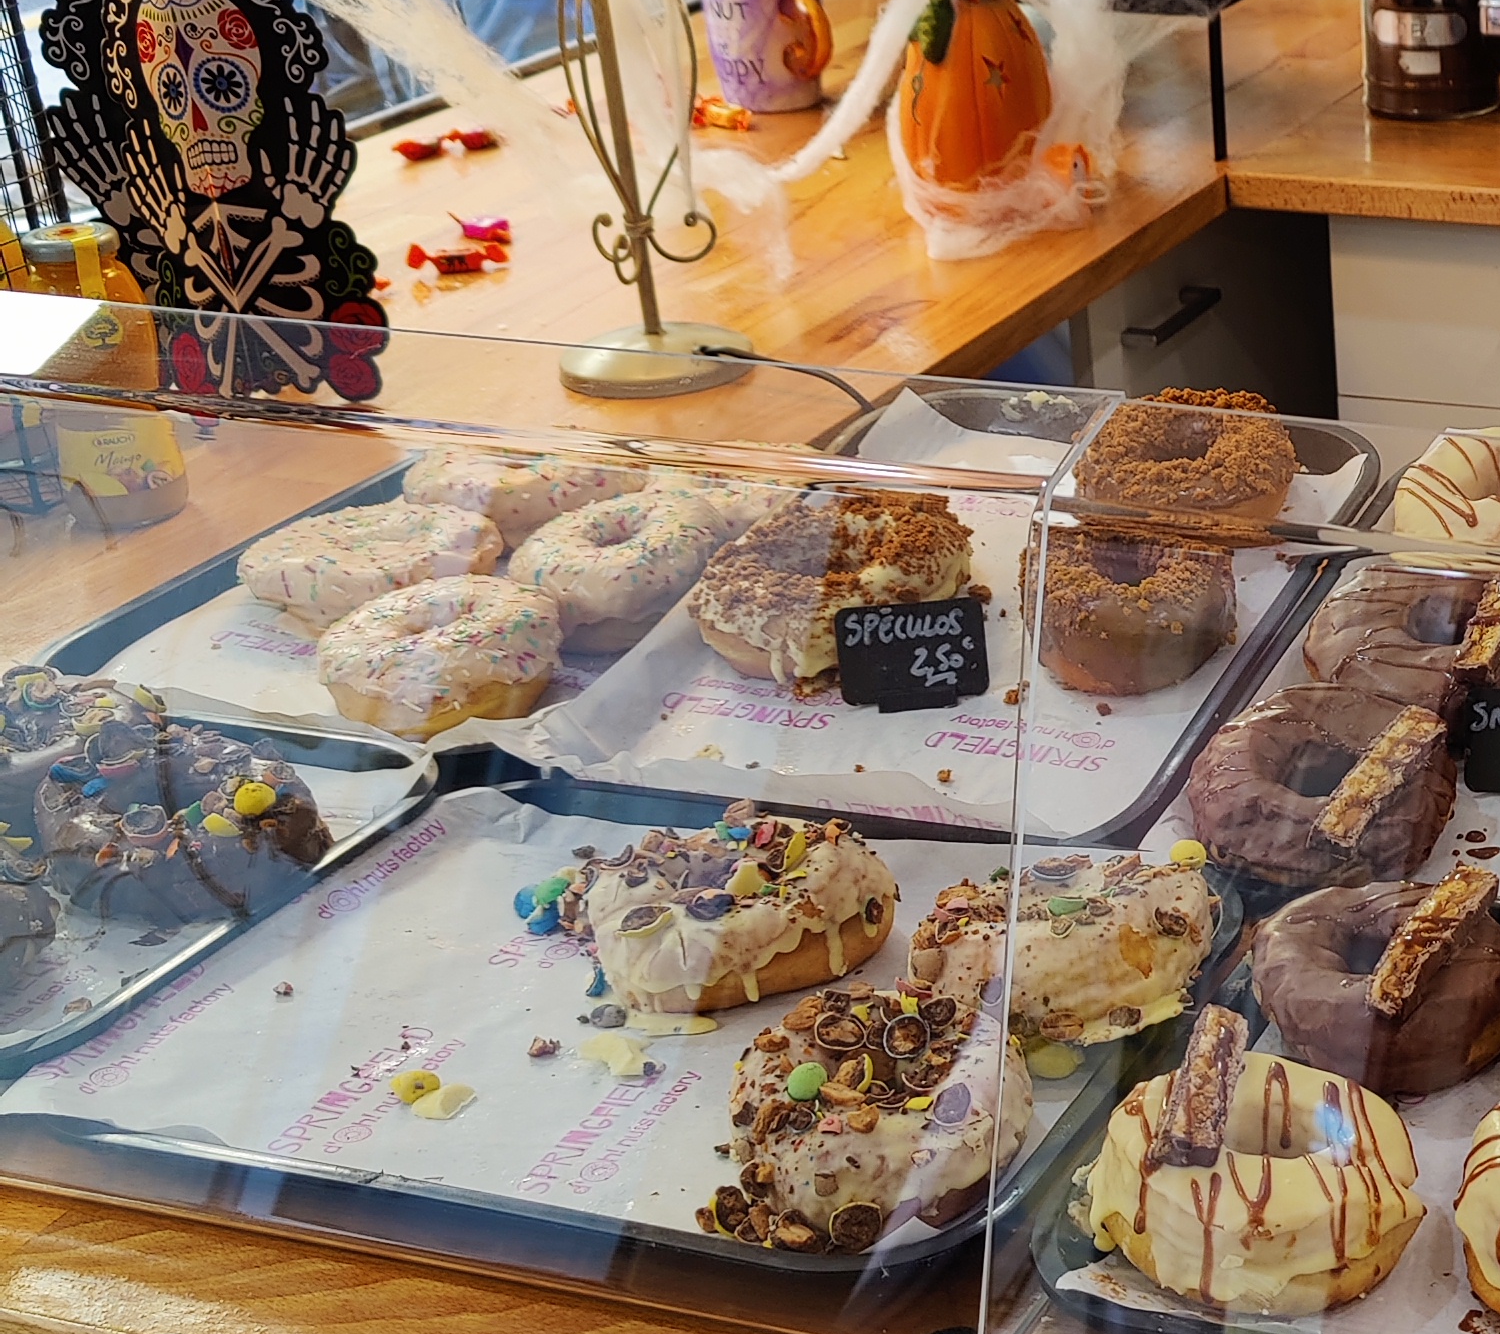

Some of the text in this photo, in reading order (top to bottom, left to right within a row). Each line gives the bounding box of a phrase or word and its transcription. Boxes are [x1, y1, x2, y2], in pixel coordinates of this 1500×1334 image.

[662, 691, 835, 730] SPRINGFIELD
[362, 855, 400, 889] nuts
[392, 818, 447, 868] factory
[137, 1023, 178, 1056] nuts
[170, 981, 235, 1033] factory
[619, 1112, 653, 1148] nuts
[645, 1069, 702, 1117] factory
